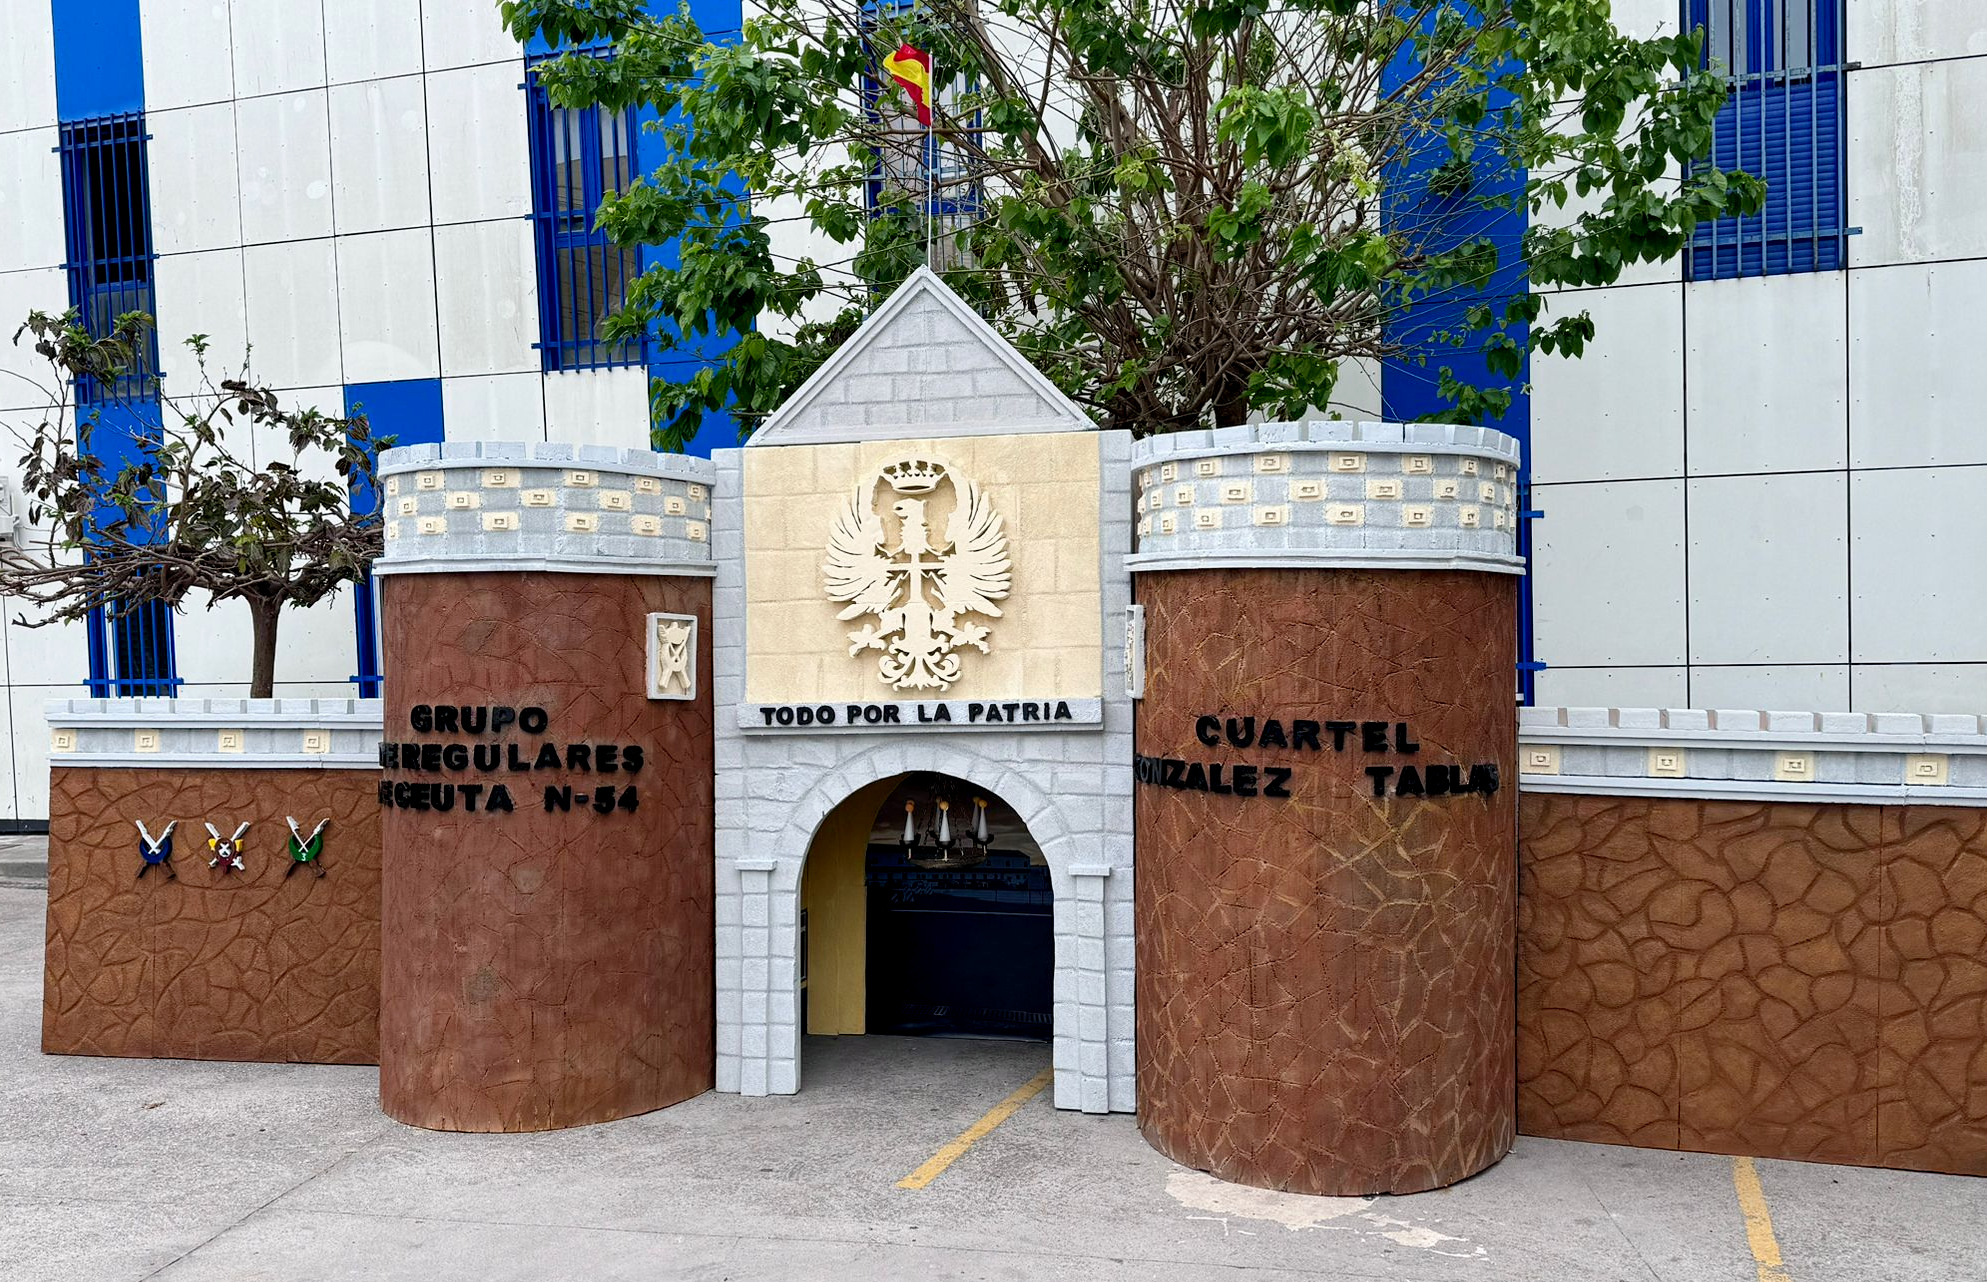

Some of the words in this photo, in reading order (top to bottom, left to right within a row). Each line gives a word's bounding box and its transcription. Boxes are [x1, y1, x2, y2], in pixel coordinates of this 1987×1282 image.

[411, 704, 548, 734] GRUPO
[760, 706, 835, 726] TODO
[847, 705, 900, 723] POR
[918, 703, 951, 722] LA
[968, 701, 1072, 722] PATRIA
[1195, 715, 1420, 753] CUARTEL
[544, 785, 639, 814] N-54
